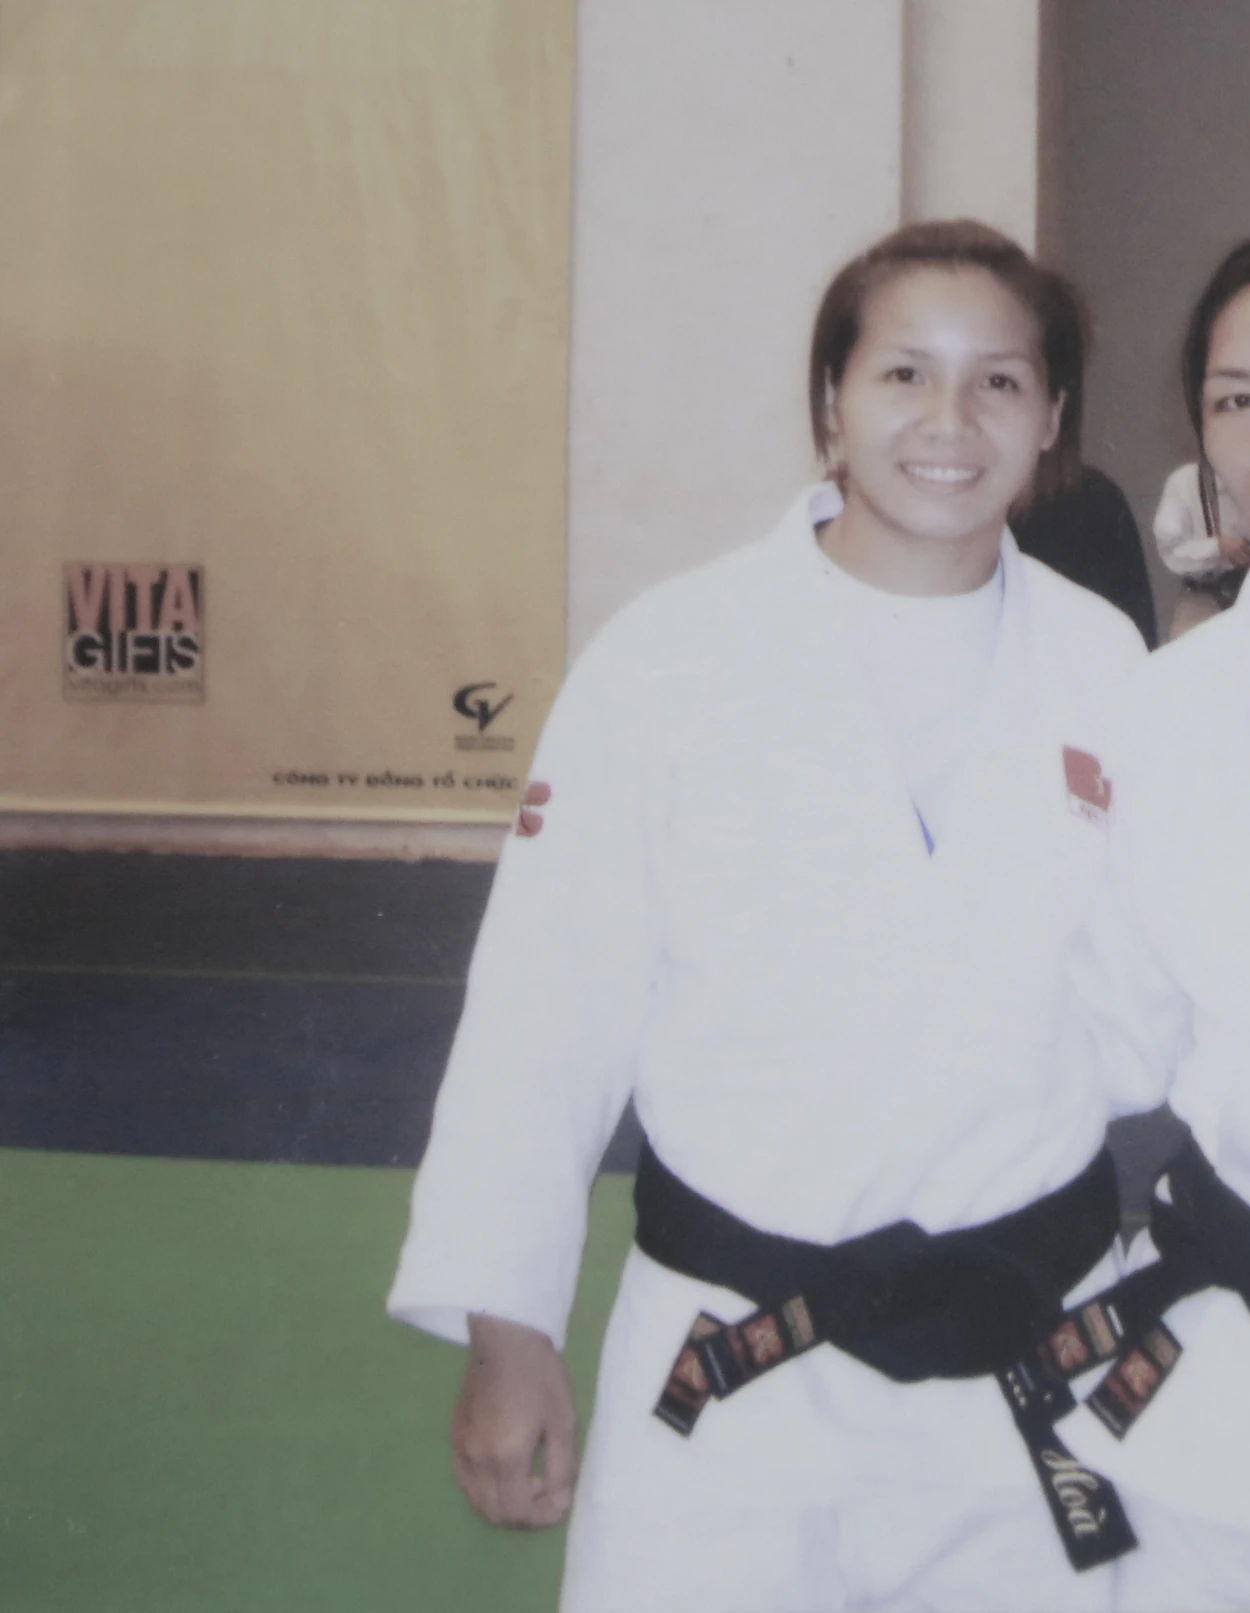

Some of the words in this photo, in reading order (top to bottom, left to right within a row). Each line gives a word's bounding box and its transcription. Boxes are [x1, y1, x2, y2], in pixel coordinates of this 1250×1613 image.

[67, 566, 200, 631] VITA
[67, 631, 199, 675] GIFTS
[337, 773, 360, 787] TY
